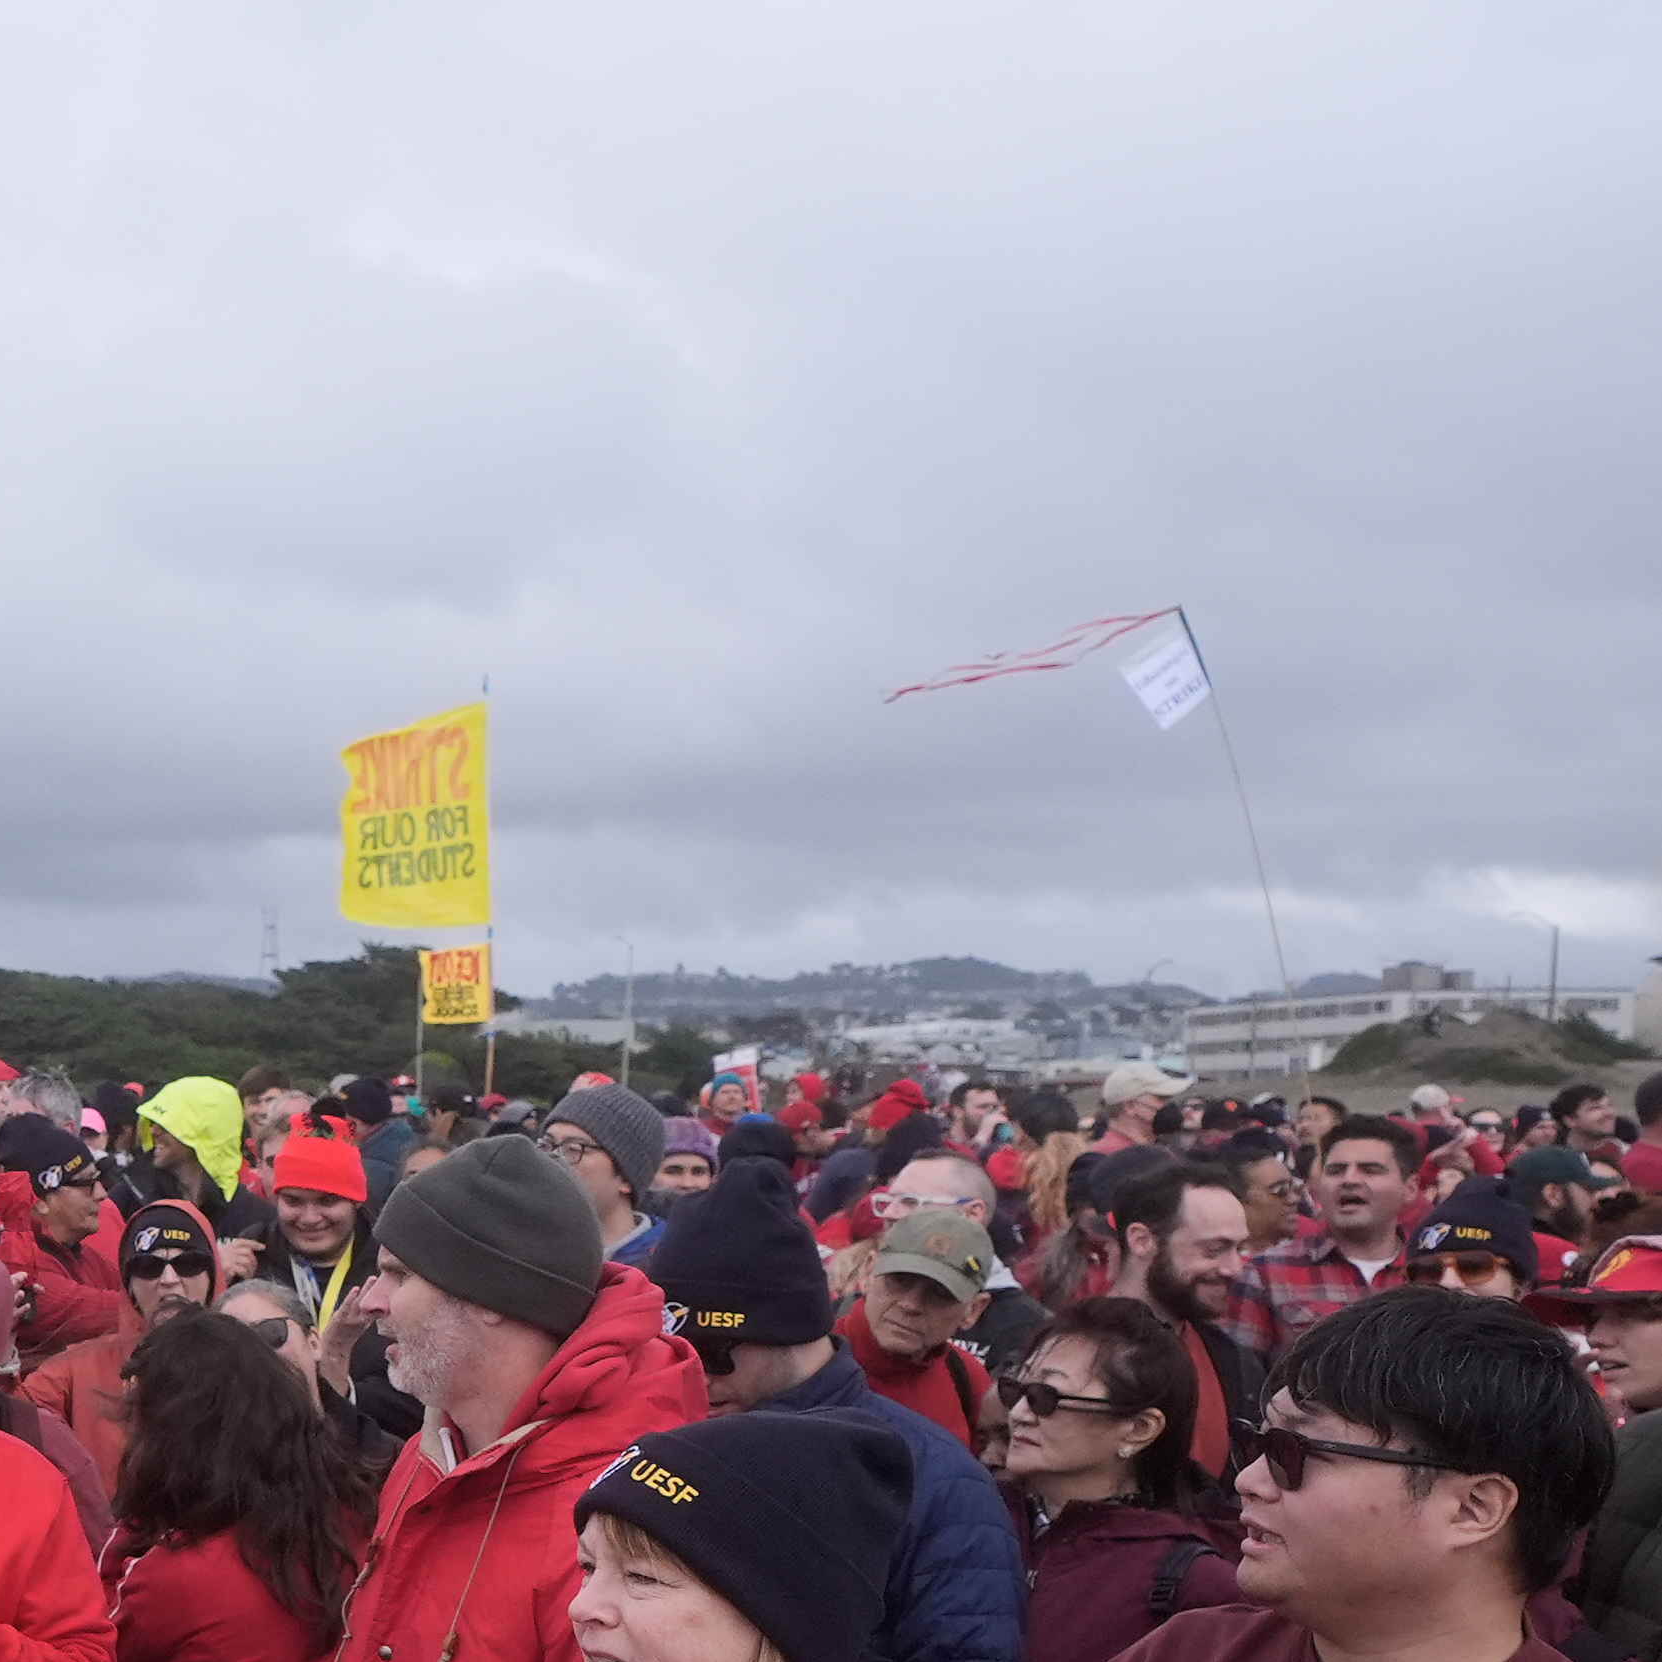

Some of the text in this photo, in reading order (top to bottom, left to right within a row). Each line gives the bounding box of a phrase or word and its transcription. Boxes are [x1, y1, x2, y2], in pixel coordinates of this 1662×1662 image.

[162, 1229, 191, 1241] UESF
[1455, 1227, 1493, 1240] UESF
[696, 1309, 746, 1329] UESF
[628, 1457, 701, 1505] UESF
